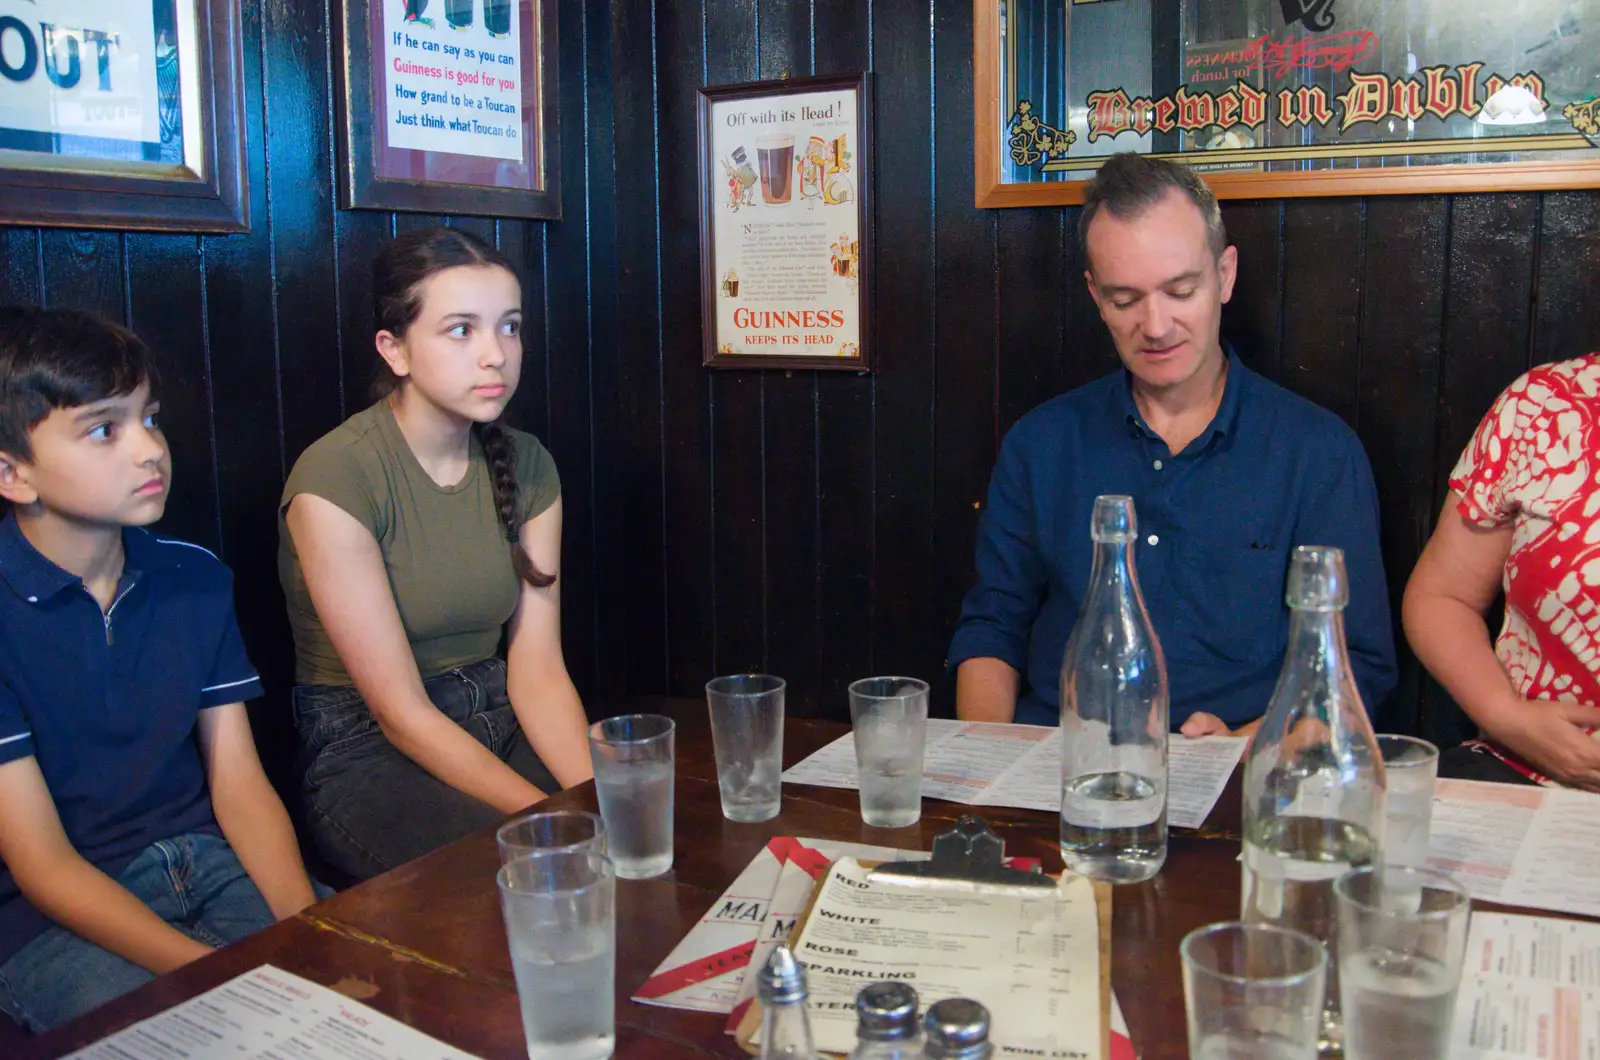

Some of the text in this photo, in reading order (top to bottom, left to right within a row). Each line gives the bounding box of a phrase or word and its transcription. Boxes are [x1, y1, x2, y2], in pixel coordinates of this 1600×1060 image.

[393, 31, 514, 66] If he can say as you can
[393, 57, 515, 92] Guinness is good for you
[395, 83, 516, 114] How grand to be a Toucan
[1086, 61, 1550, 143] Brewed in Dublin
[395, 109, 517, 138] Just think what Toucan do
[726, 112, 748, 127] Off
[750, 110, 776, 124] with
[781, 109, 796, 122] its
[801, 104, 833, 121] Head
[733, 307, 844, 329] GUINNESS
[745, 334, 834, 345] KEEPS ITS HEAD
[835, 872, 871, 890] RED
[820, 908, 881, 925] WHITE
[804, 941, 859, 957] ROSE
[799, 962, 917, 980] SPARKLING
[1002, 1045, 1089, 1060] WINE LIST
